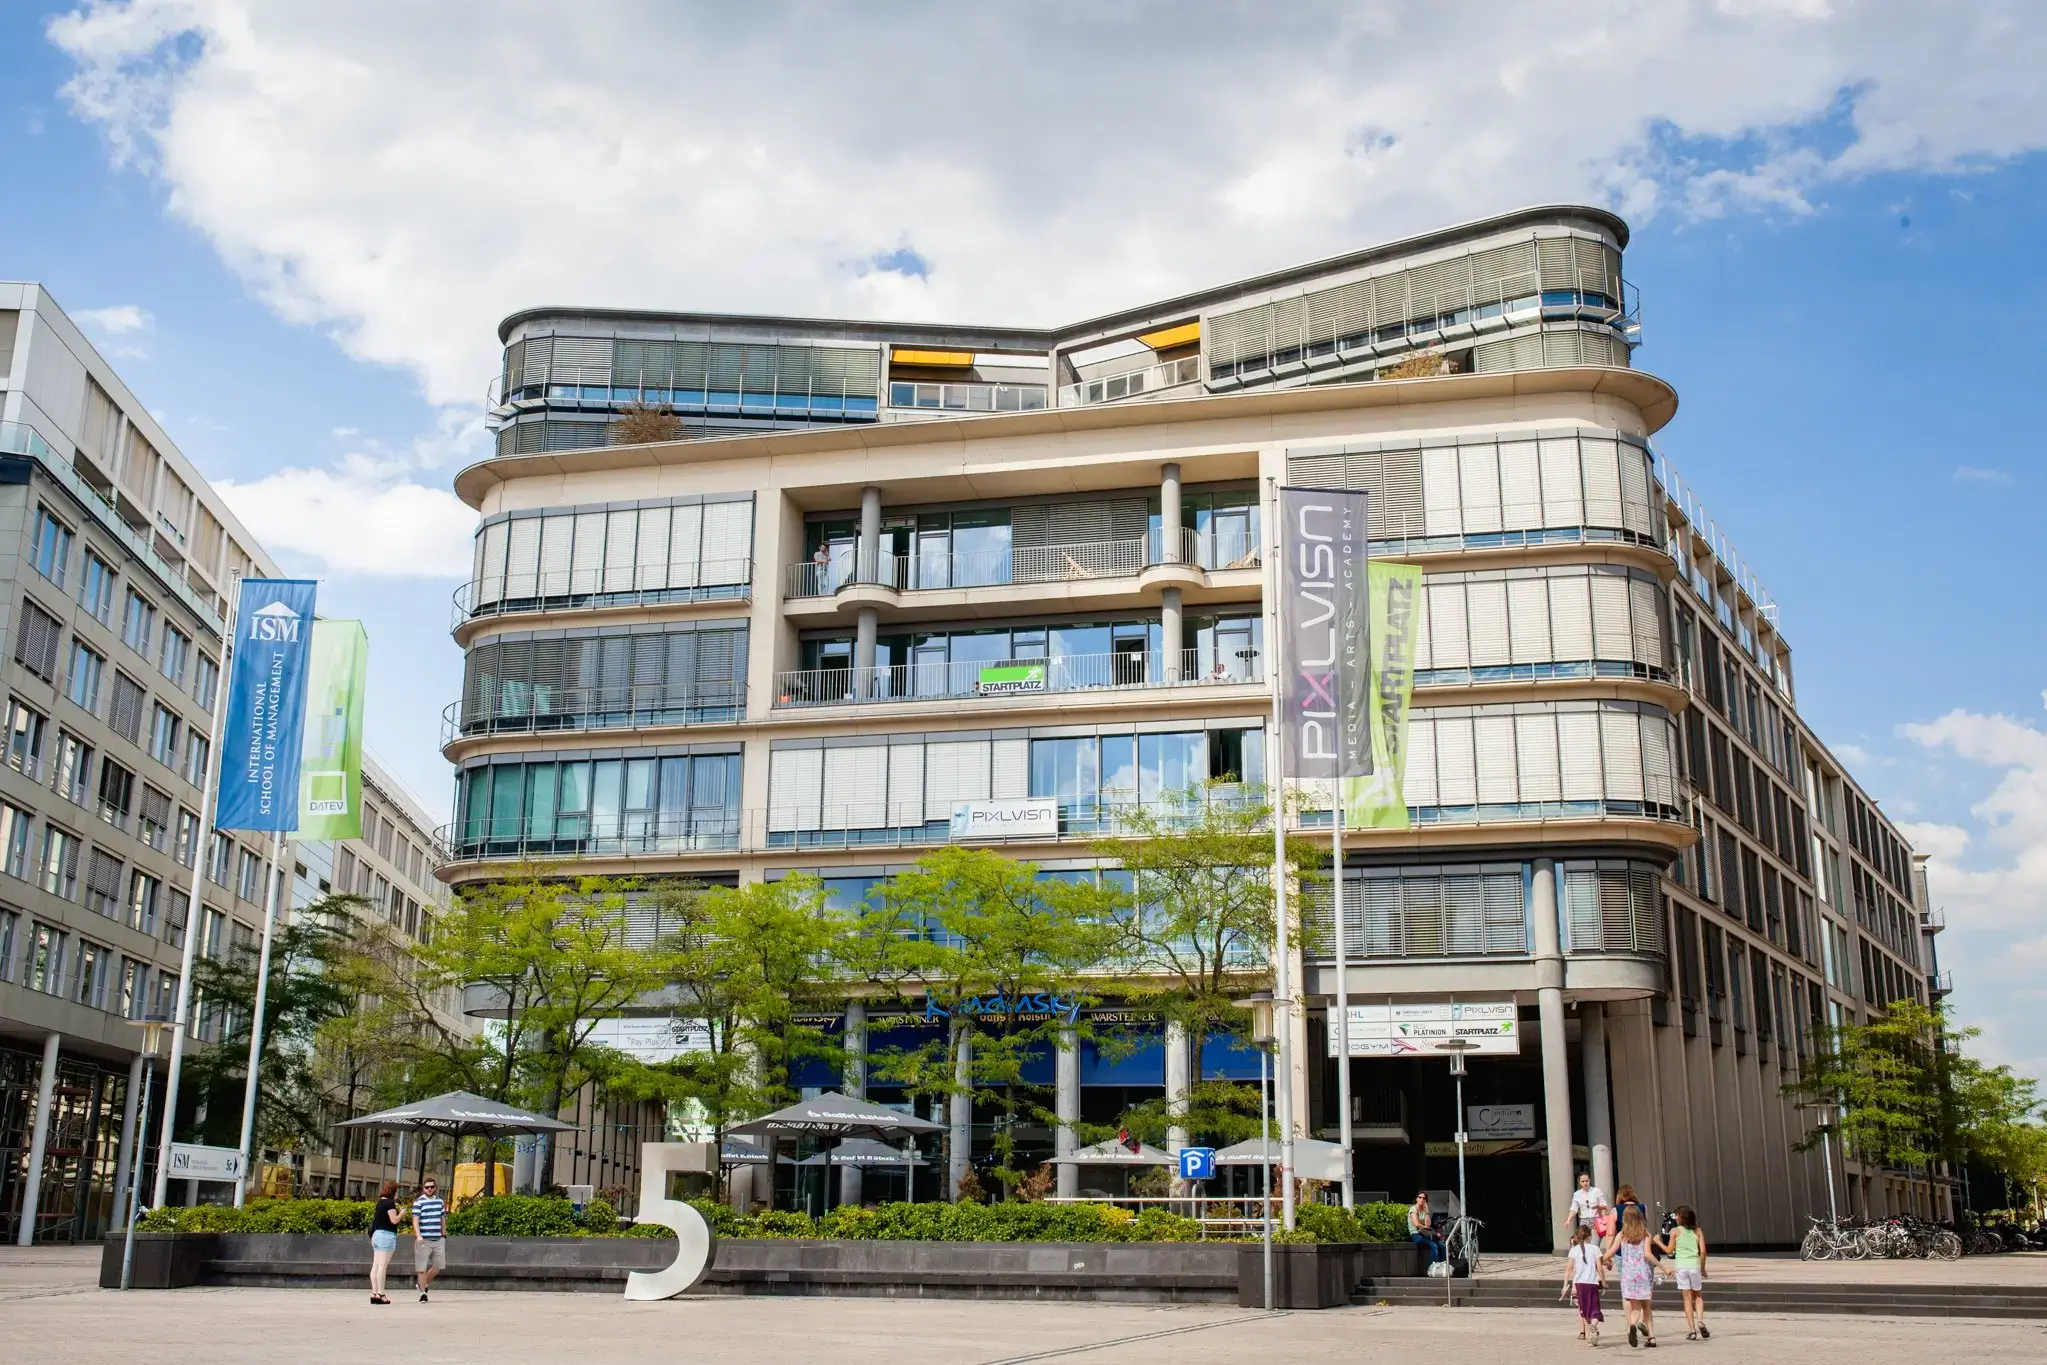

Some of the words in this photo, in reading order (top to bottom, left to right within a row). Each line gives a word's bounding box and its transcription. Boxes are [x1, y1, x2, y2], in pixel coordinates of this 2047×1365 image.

[1342, 507, 1353, 590] ACADEMY
[249, 616, 301, 643] ISM
[1346, 615, 1357, 668] ARTS
[982, 680, 1042, 692] STARTPLATZ
[267, 652, 285, 743] MANAGEMENT
[248, 680, 267, 784] INTERNATIONAL
[1347, 701, 1357, 759] MEDIA
[267, 743, 275, 760] OF
[260, 766, 274, 815] SCHOOL
[310, 801, 344, 812] DATEV
[1413, 1026, 1447, 1036] PLATINION
[1455, 1027, 1499, 1035] STARTPLATZ
[630, 1038, 643, 1047] Pay
[1332, 1043, 1389, 1051] NOGYM
[173, 1152, 190, 1169] ISM
[1187, 1157, 1202, 1177] P
[624, 1142, 713, 1300] 5
